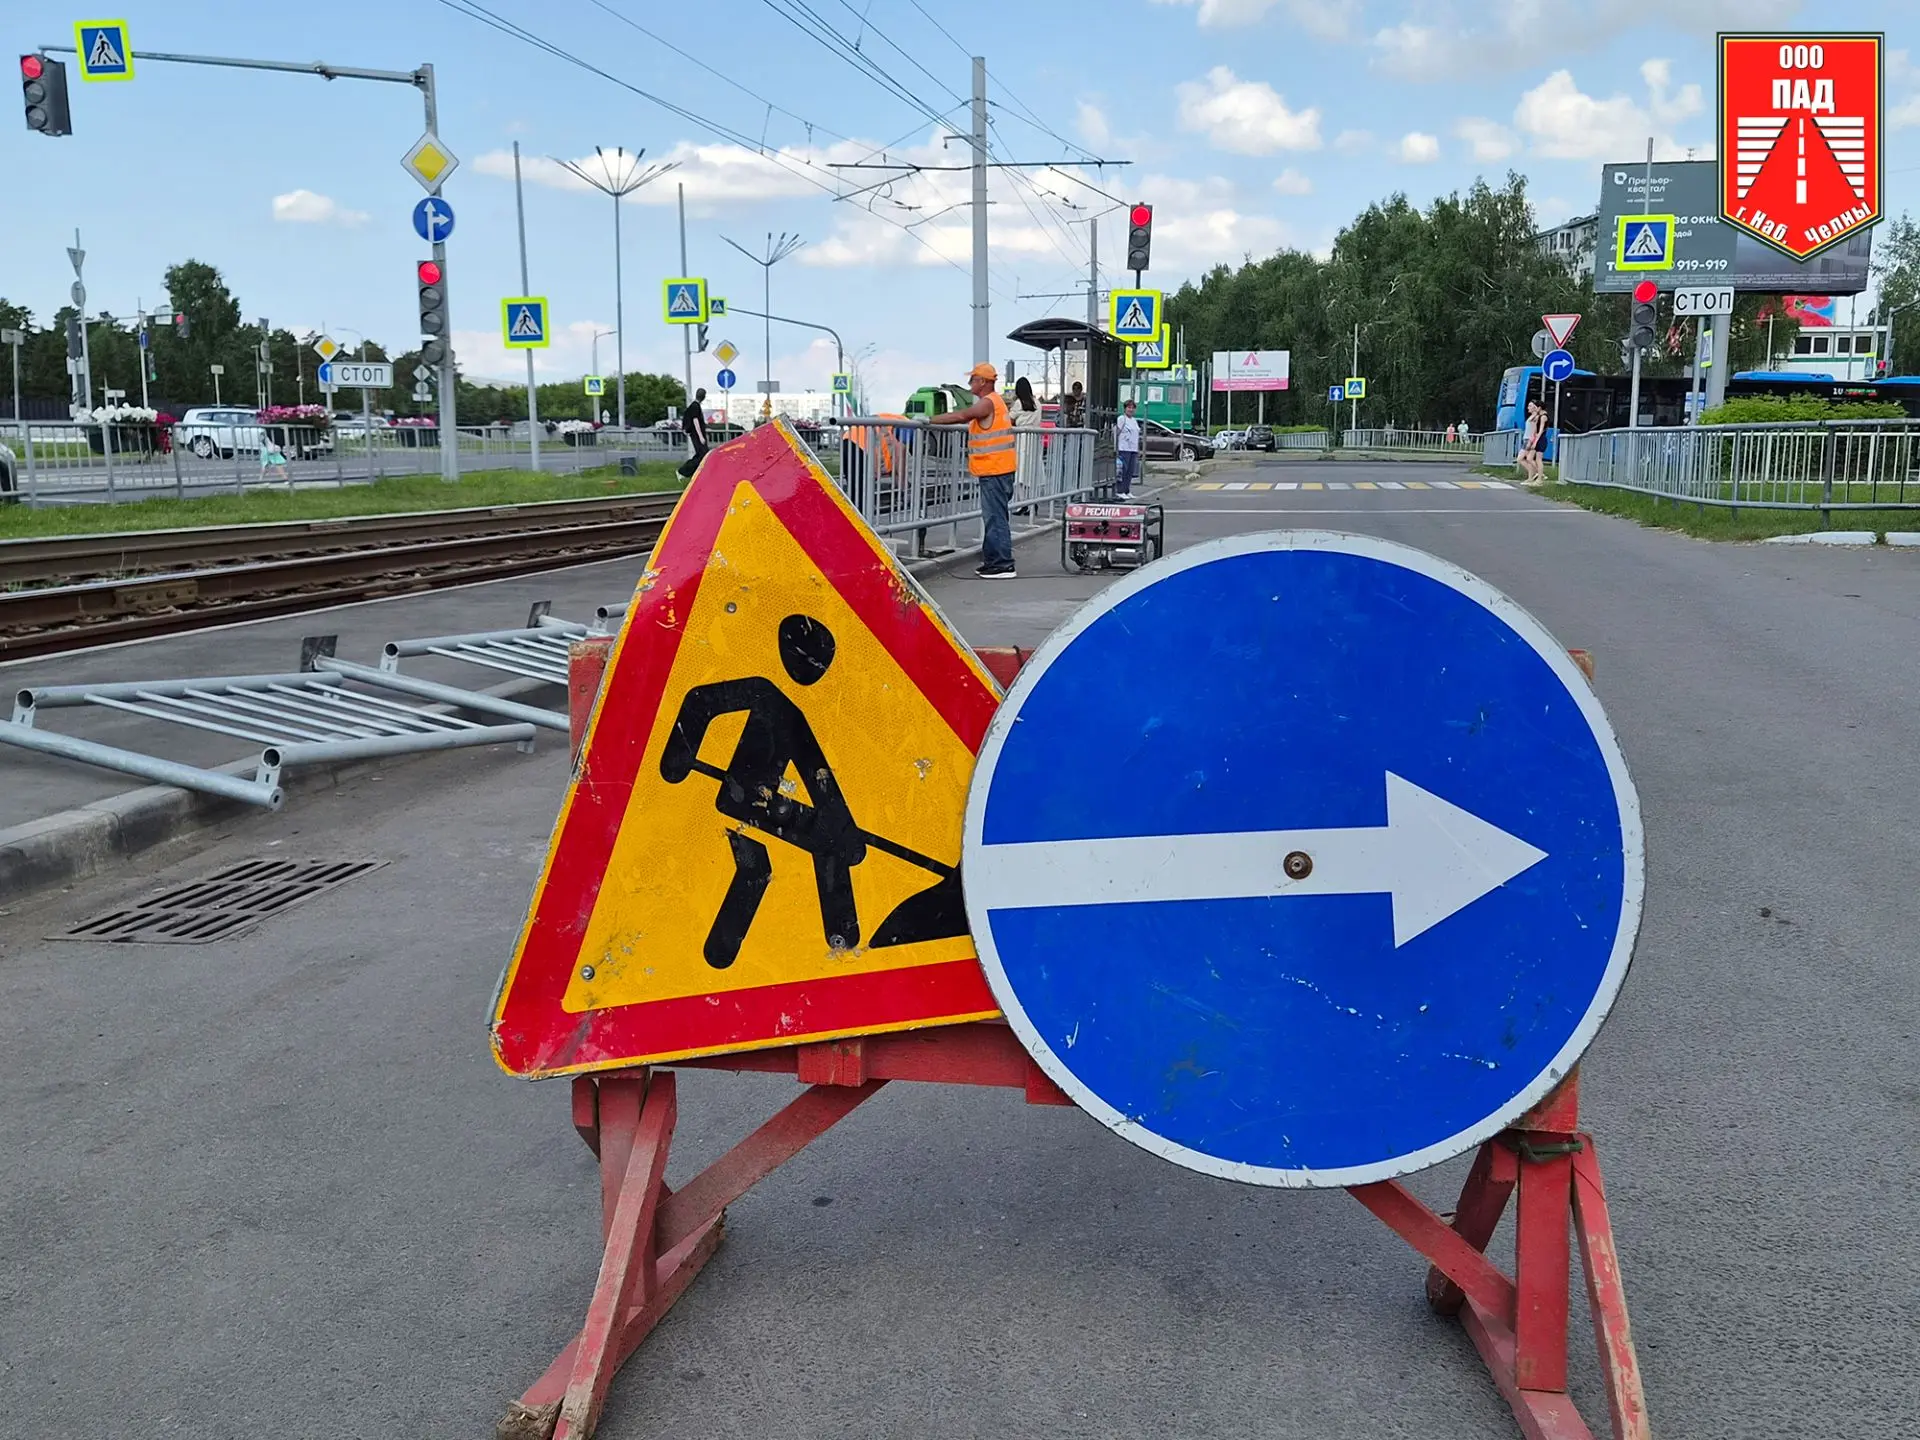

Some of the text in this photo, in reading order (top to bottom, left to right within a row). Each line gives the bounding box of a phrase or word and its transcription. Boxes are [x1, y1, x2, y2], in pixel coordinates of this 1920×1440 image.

[1676, 259, 1728, 271] 919-919
[1676, 292, 1731, 311] СТОП
[341, 366, 384, 382] СТОП
[1084, 507, 1121, 517] РЕСАНТА
